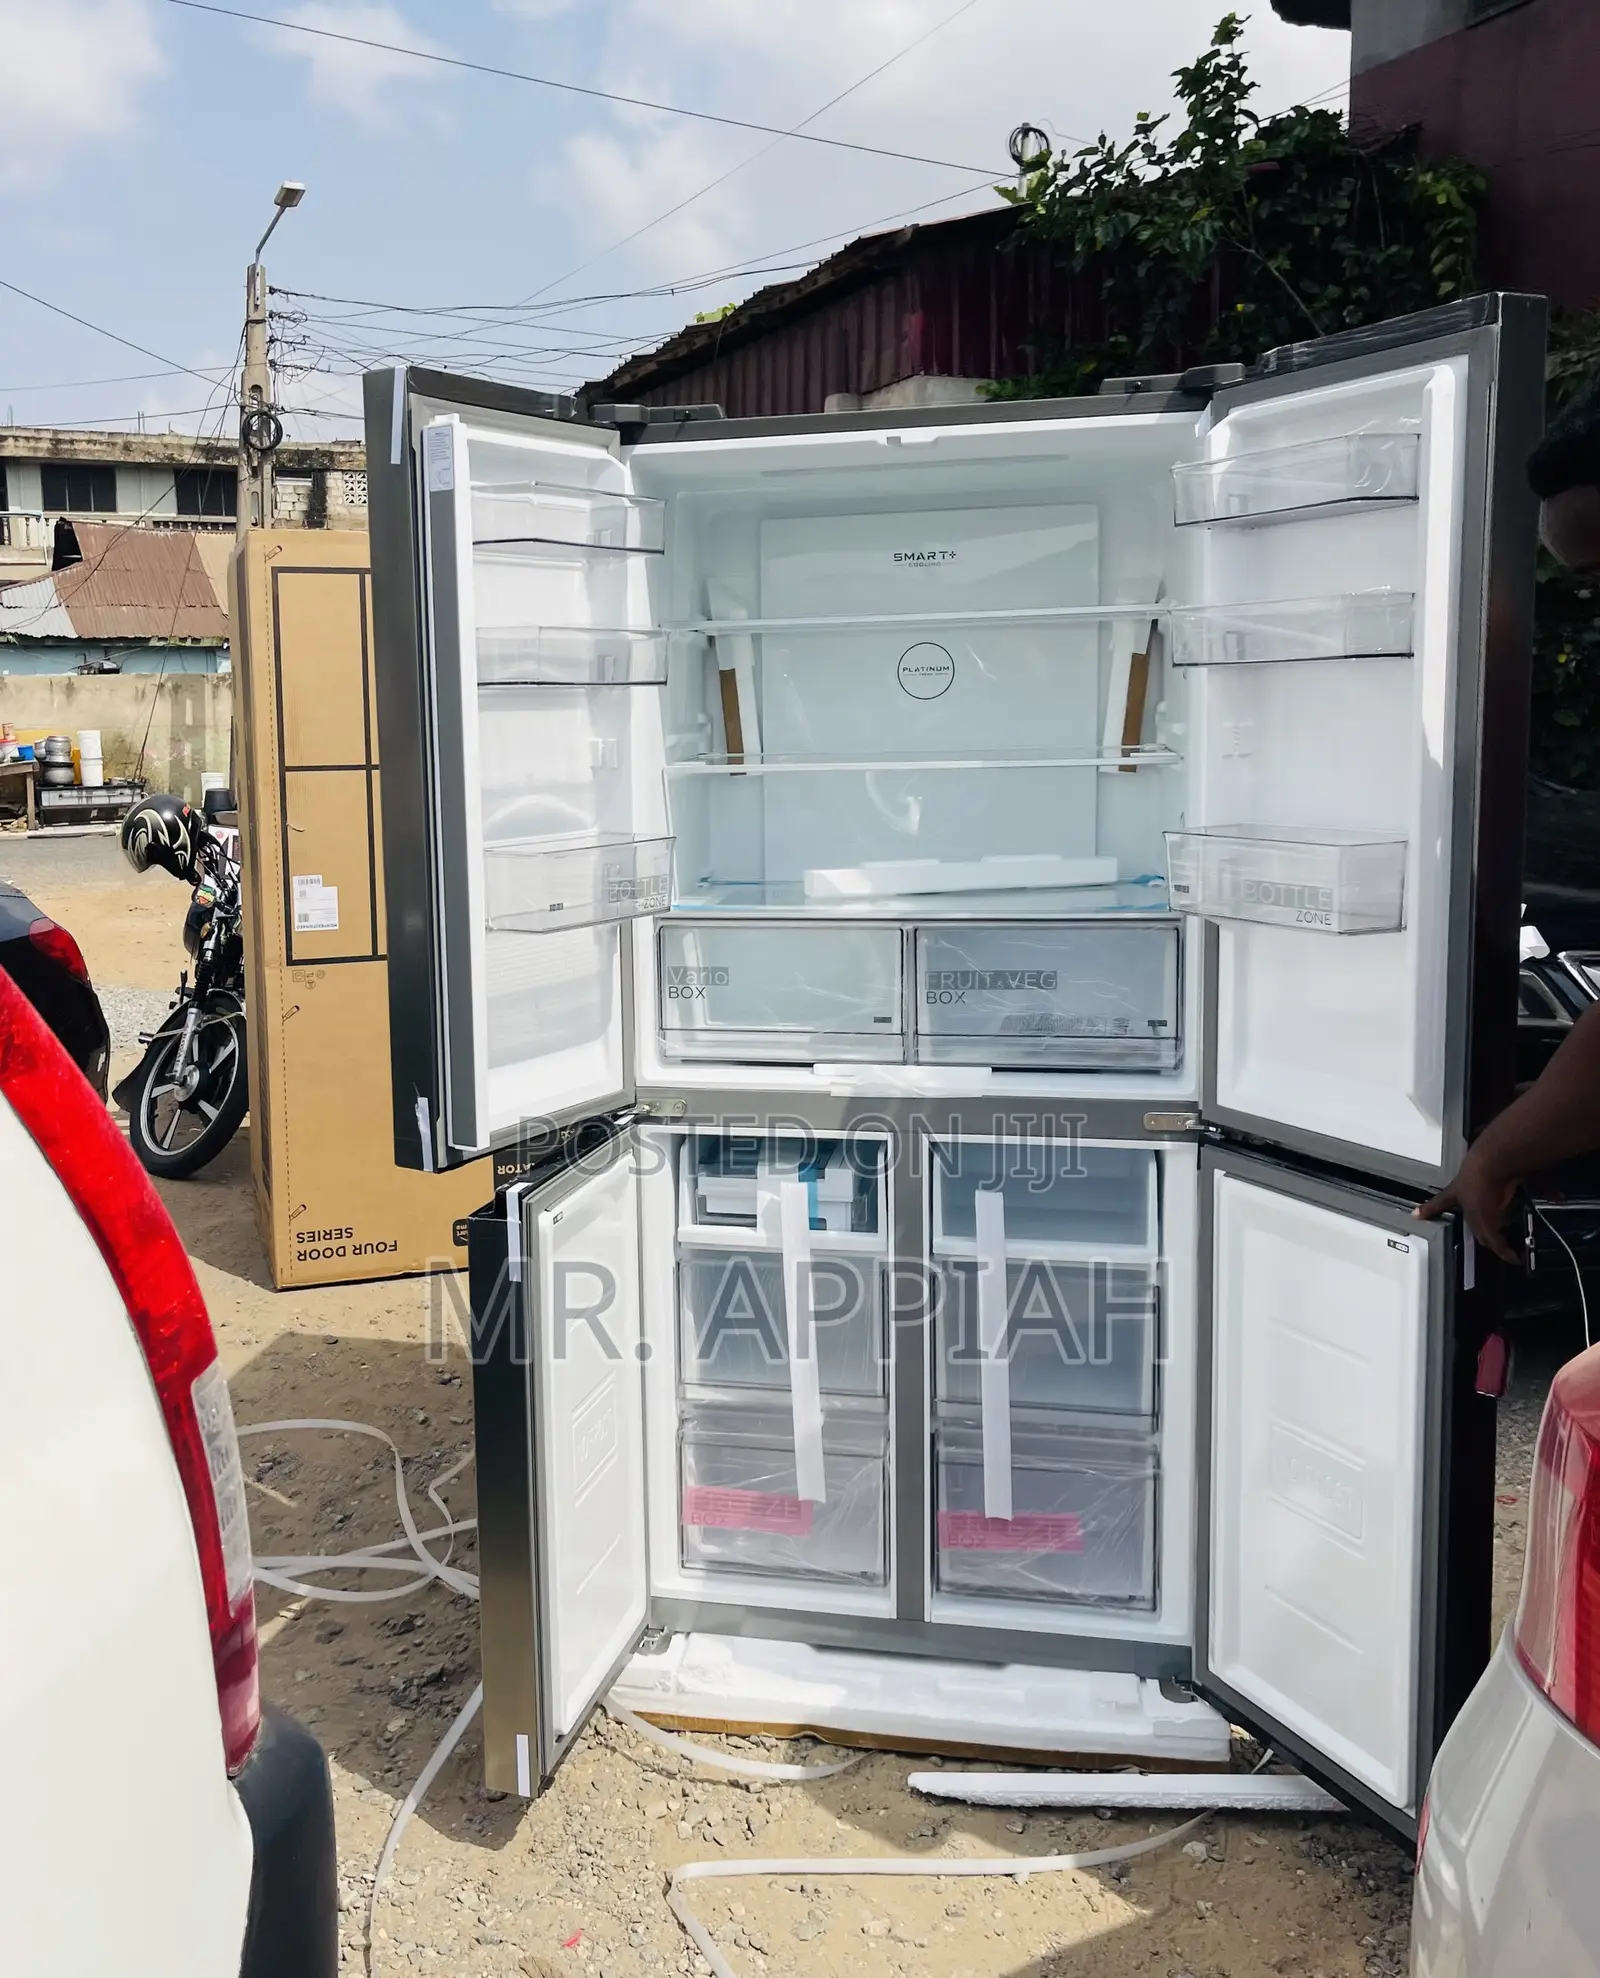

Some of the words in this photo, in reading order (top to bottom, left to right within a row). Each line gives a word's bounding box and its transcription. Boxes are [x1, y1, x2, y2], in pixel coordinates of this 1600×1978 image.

[902, 665, 950, 673] PLATINUM
[643, 896, 668, 909] ZONE
[1243, 881, 1334, 909] BOTTLE
[1295, 910, 1333, 926] ZONE
[668, 967, 728, 985] Vario
[668, 986, 706, 999] BOX
[926, 991, 966, 1004] BOX
[497, 1163, 536, 1176] ATOR
[296, 1227, 354, 1244] SERIES
[297, 1245, 347, 1262] DOOR
[352, 1239, 398, 1256] FOUR
